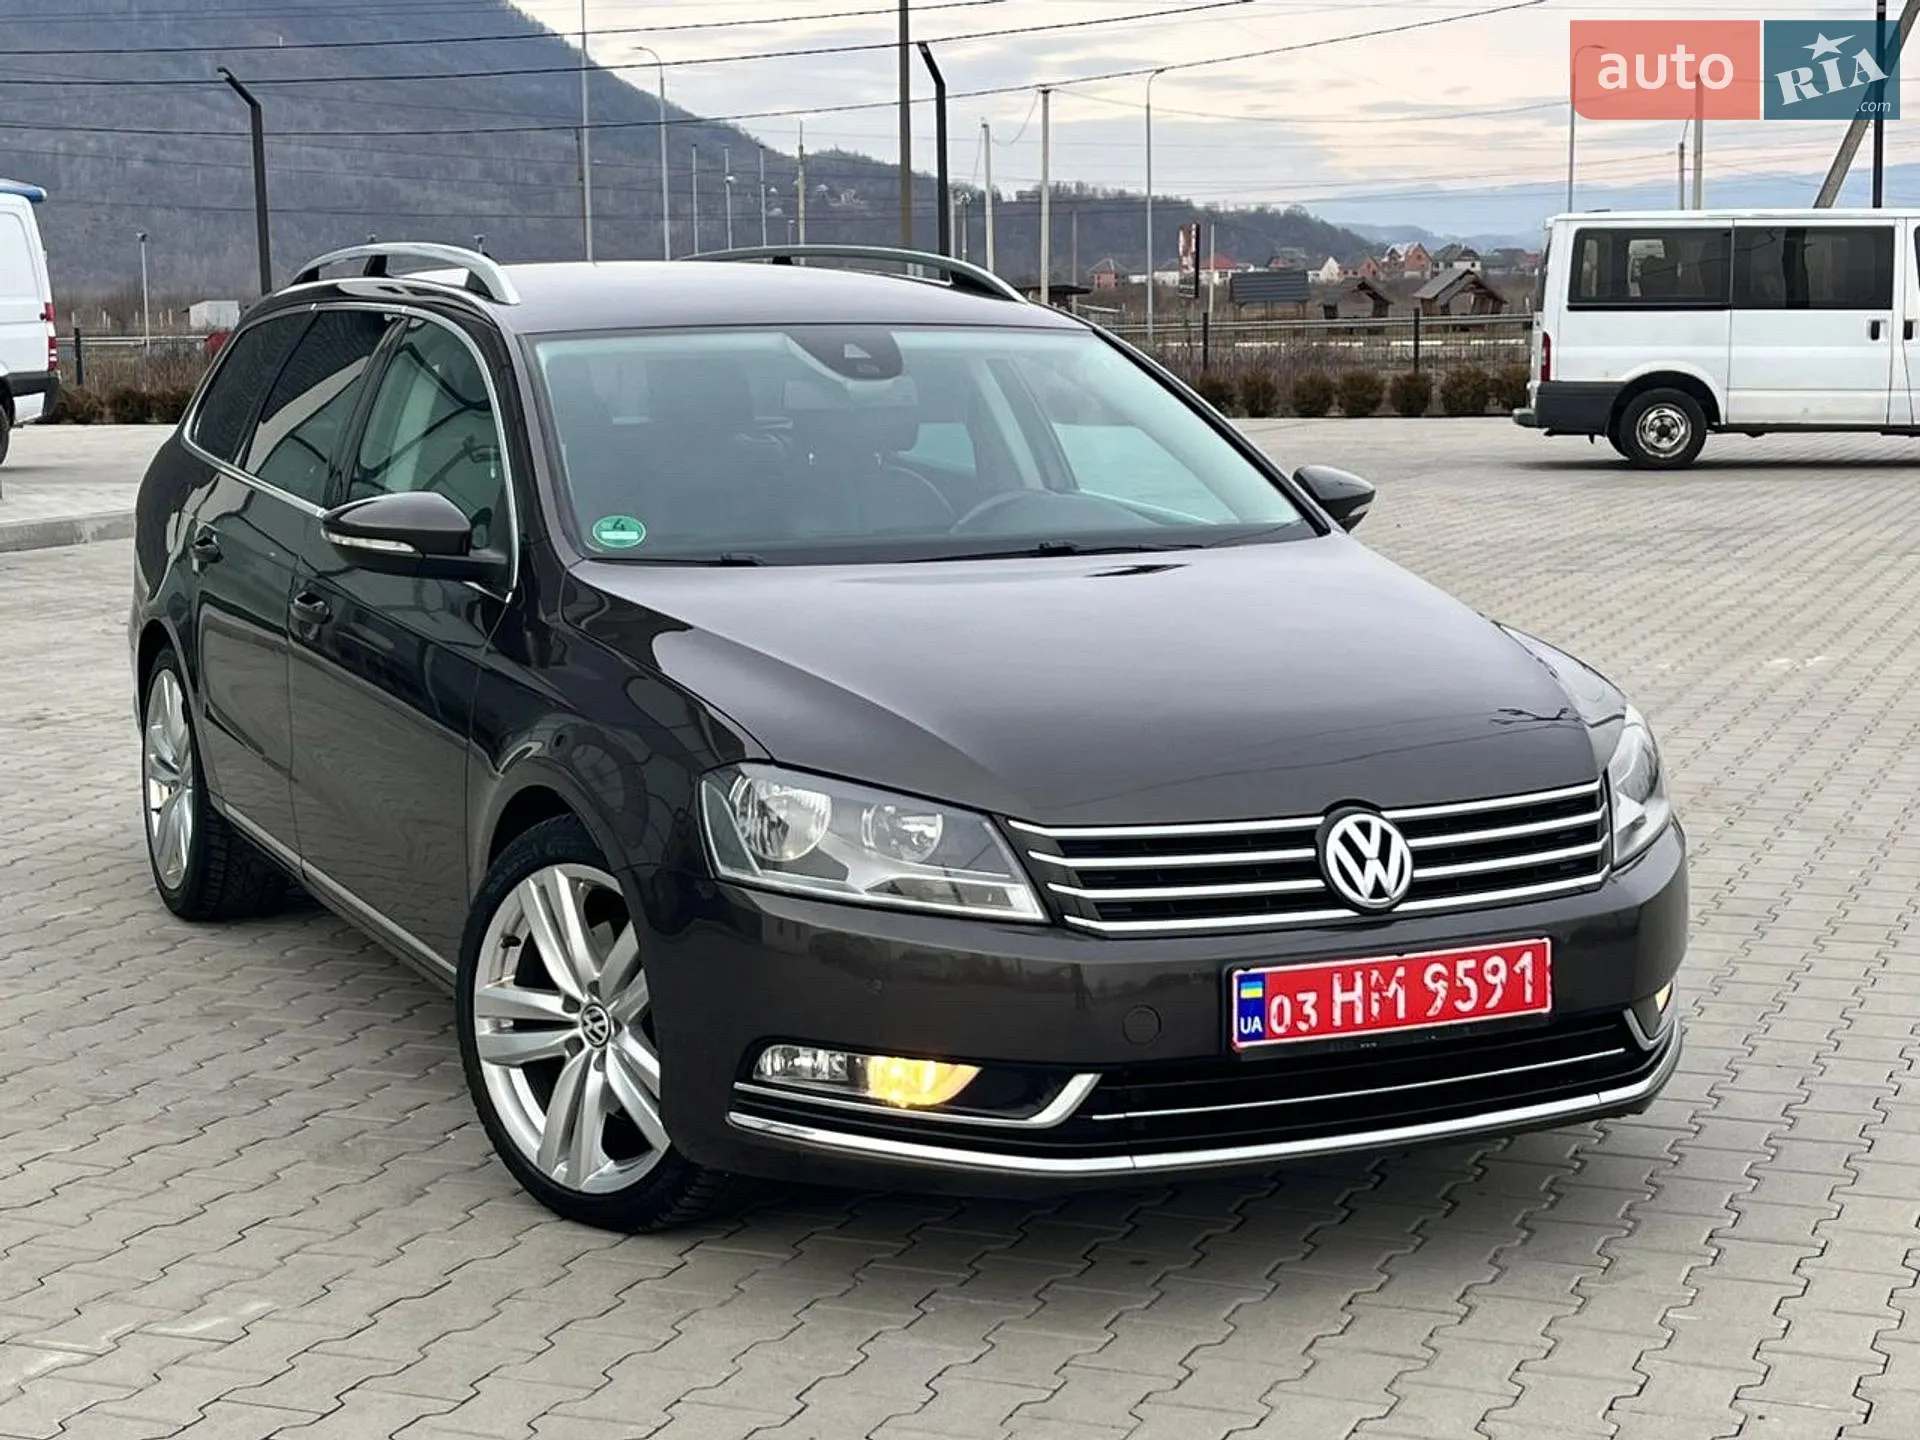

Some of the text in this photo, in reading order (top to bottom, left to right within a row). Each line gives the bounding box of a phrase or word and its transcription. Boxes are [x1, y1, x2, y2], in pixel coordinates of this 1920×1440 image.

[1327, 813, 1411, 907] VW
[1240, 1016, 1263, 1034] UA
[1269, 991, 1318, 1034] 03
[1423, 951, 1533, 1017] 9591
